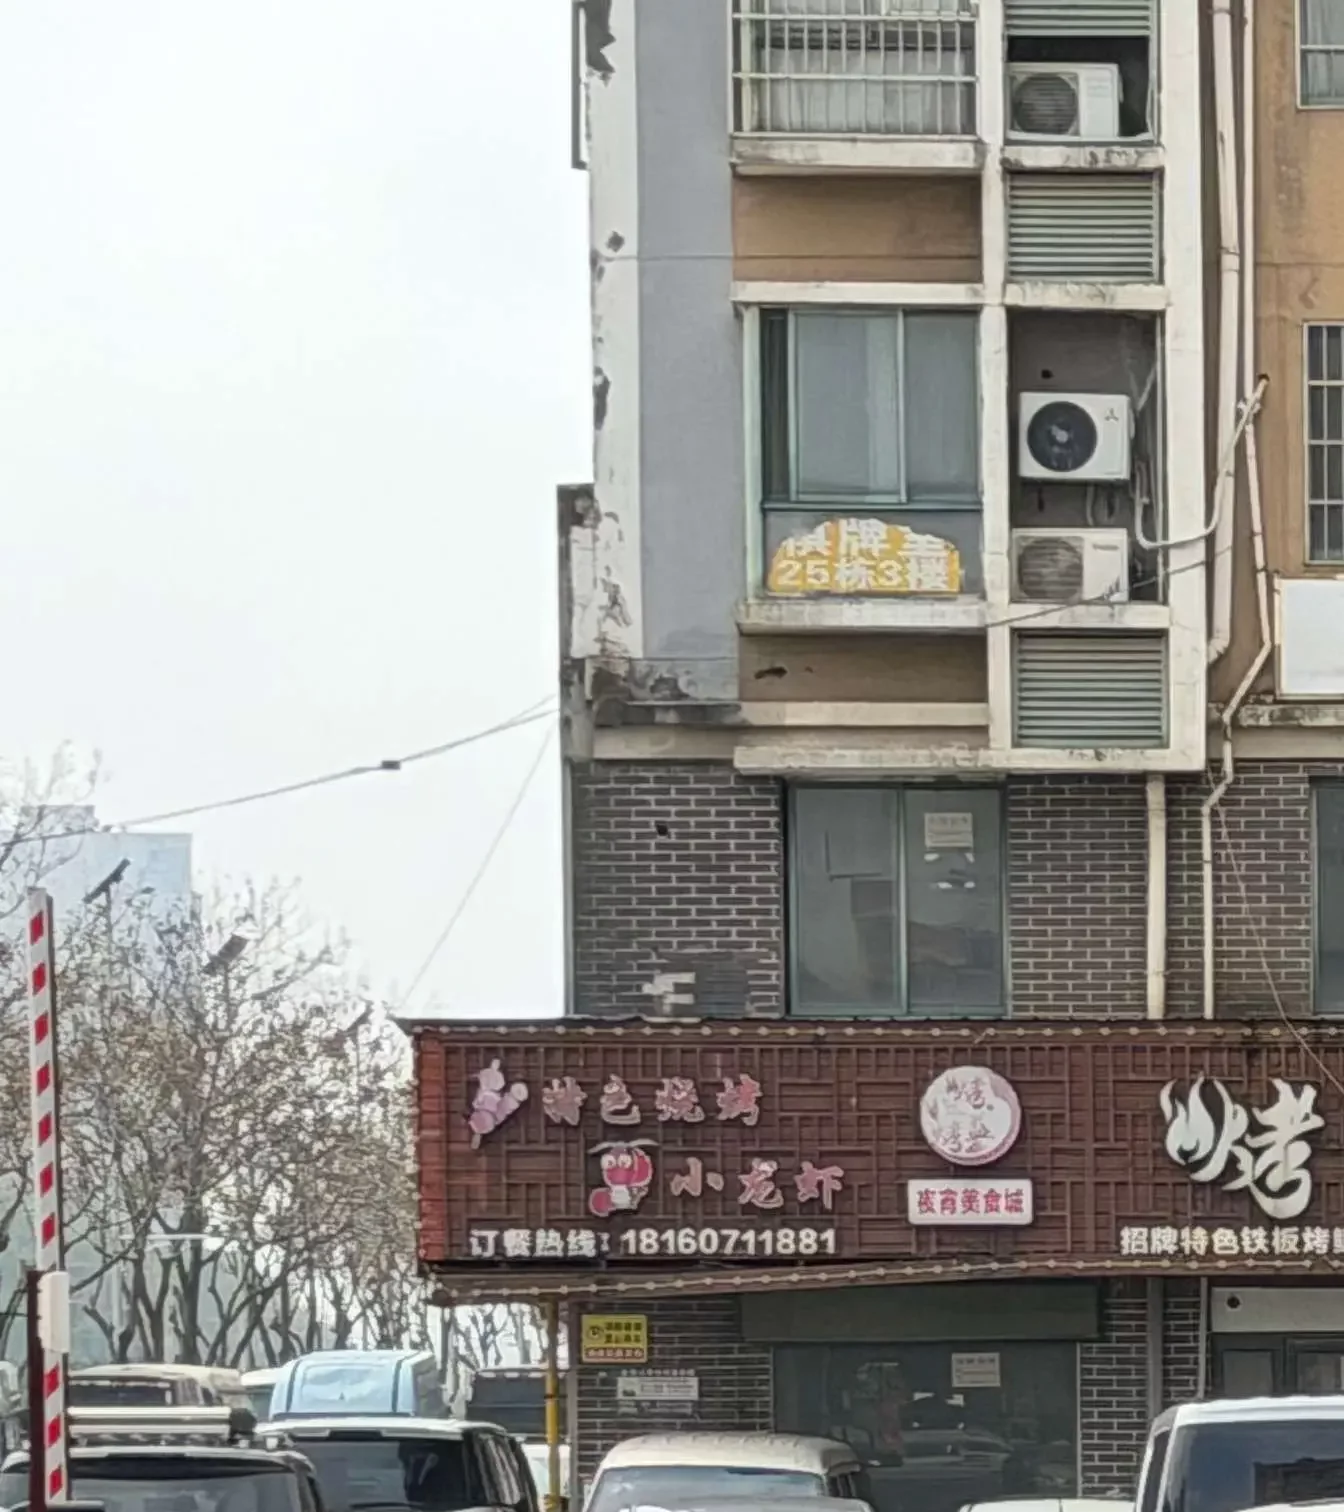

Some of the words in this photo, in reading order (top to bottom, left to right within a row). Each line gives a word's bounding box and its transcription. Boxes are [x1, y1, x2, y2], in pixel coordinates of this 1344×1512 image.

[670, 1157, 845, 1210] 小龙虾
[620, 1227, 836, 1256] 18160711881
